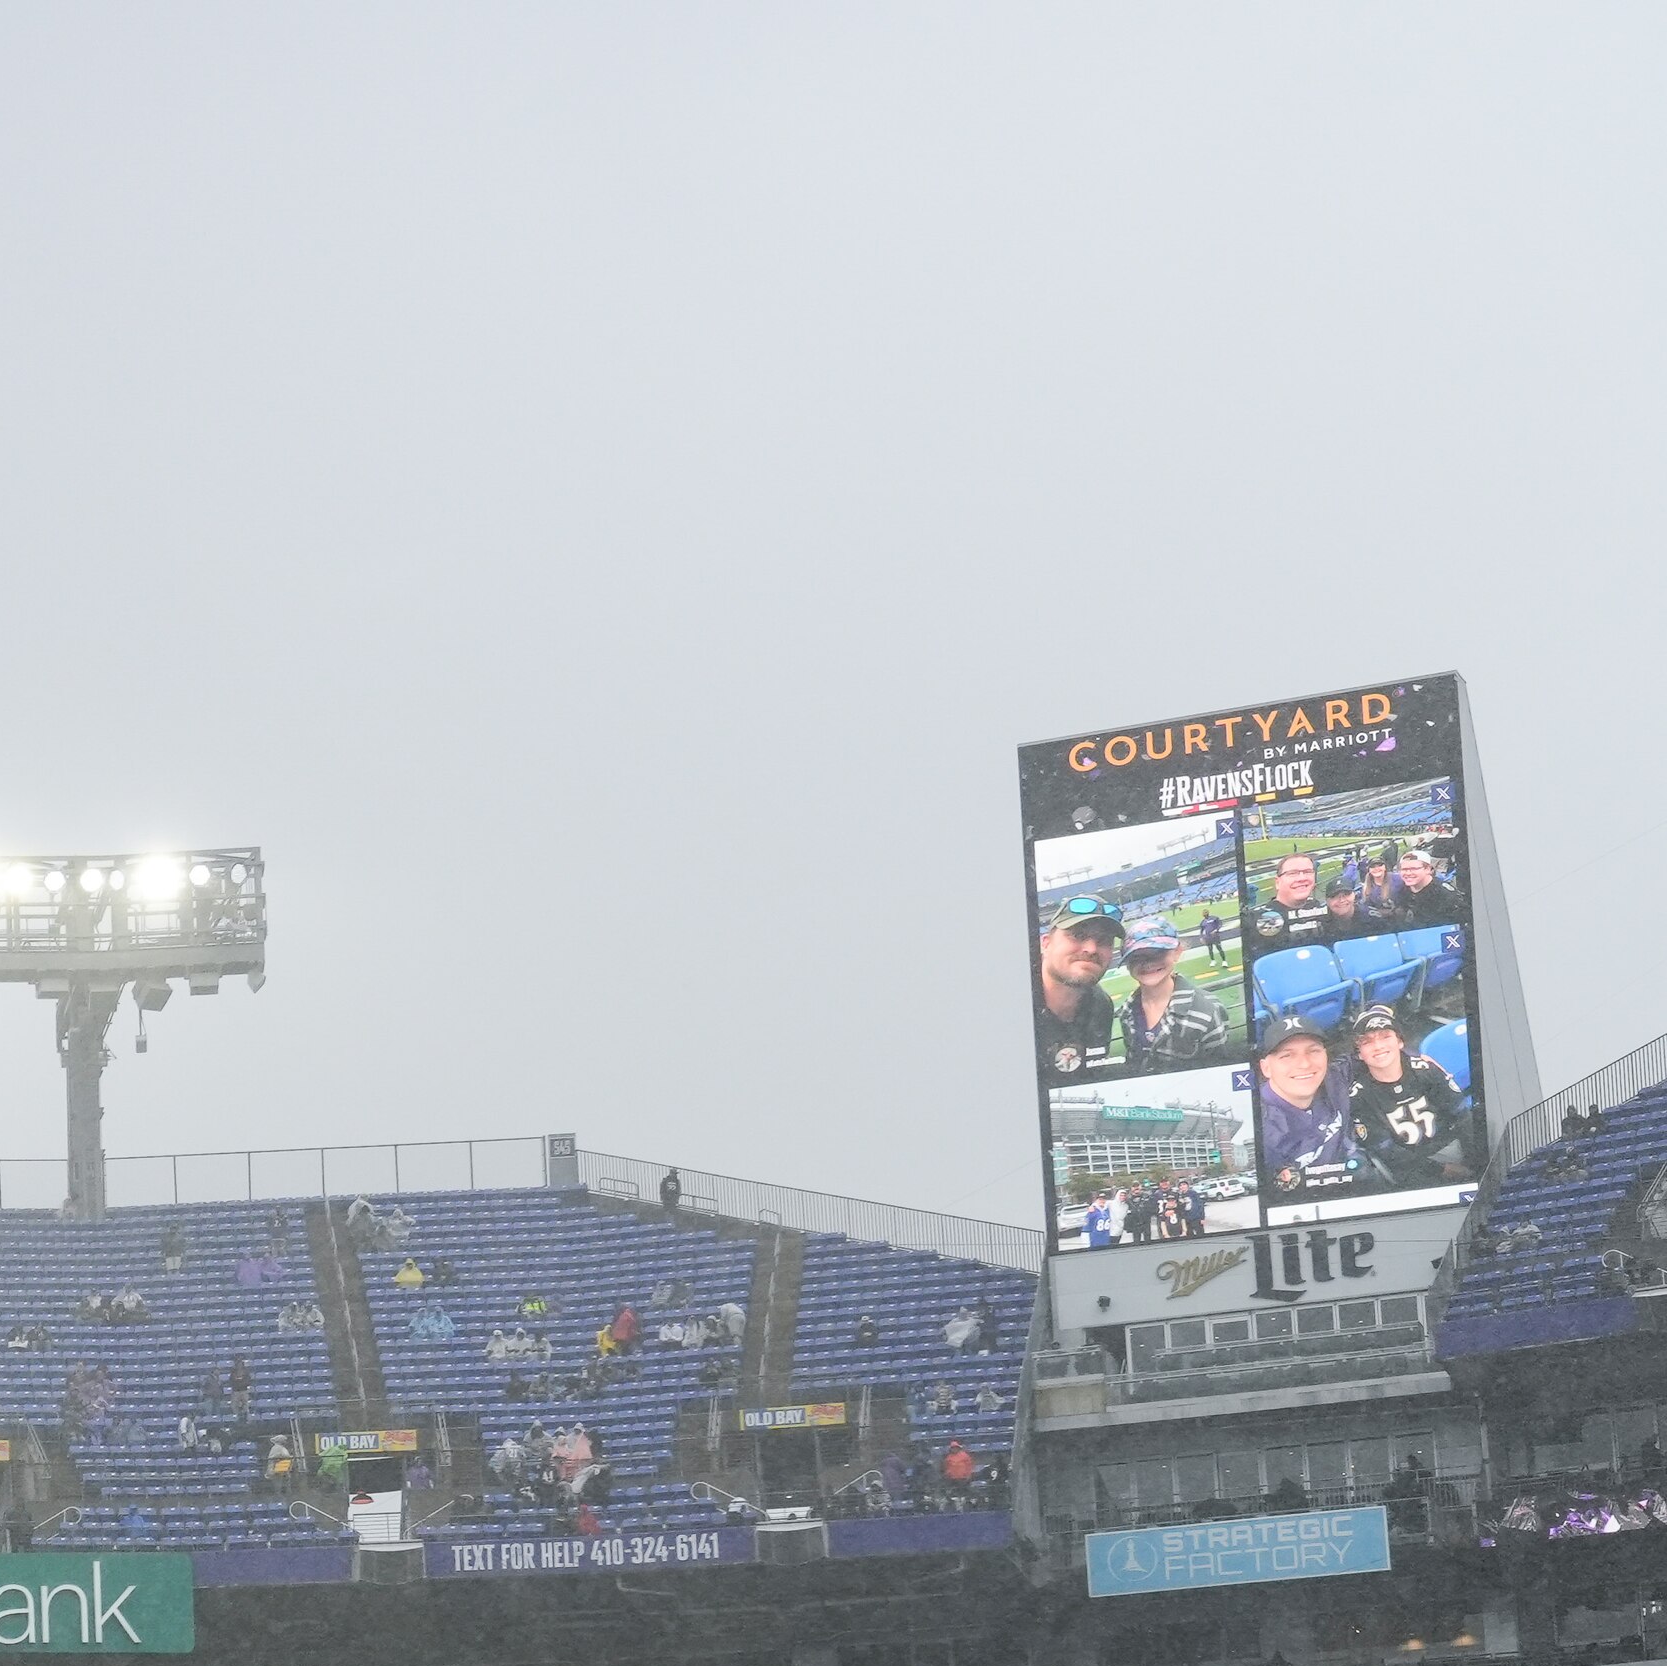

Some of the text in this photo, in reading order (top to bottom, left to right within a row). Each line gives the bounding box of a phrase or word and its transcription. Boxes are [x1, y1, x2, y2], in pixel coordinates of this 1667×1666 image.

[1068, 692, 1393, 772] COURTYARD
[1263, 728, 1393, 759] BY MARRIOTT
[1386, 1095, 1434, 1144] 55
[1155, 1230, 1374, 1302] Miller Lite
[744, 1407, 805, 1428] OLD BAY
[349, 1433, 377, 1451] BAY
[451, 1532, 720, 1572] TEXT FOR HELP 410-324-6141
[1163, 1516, 1353, 1551] STRATEGIC
[1164, 1540, 1353, 1580] FACTORY
